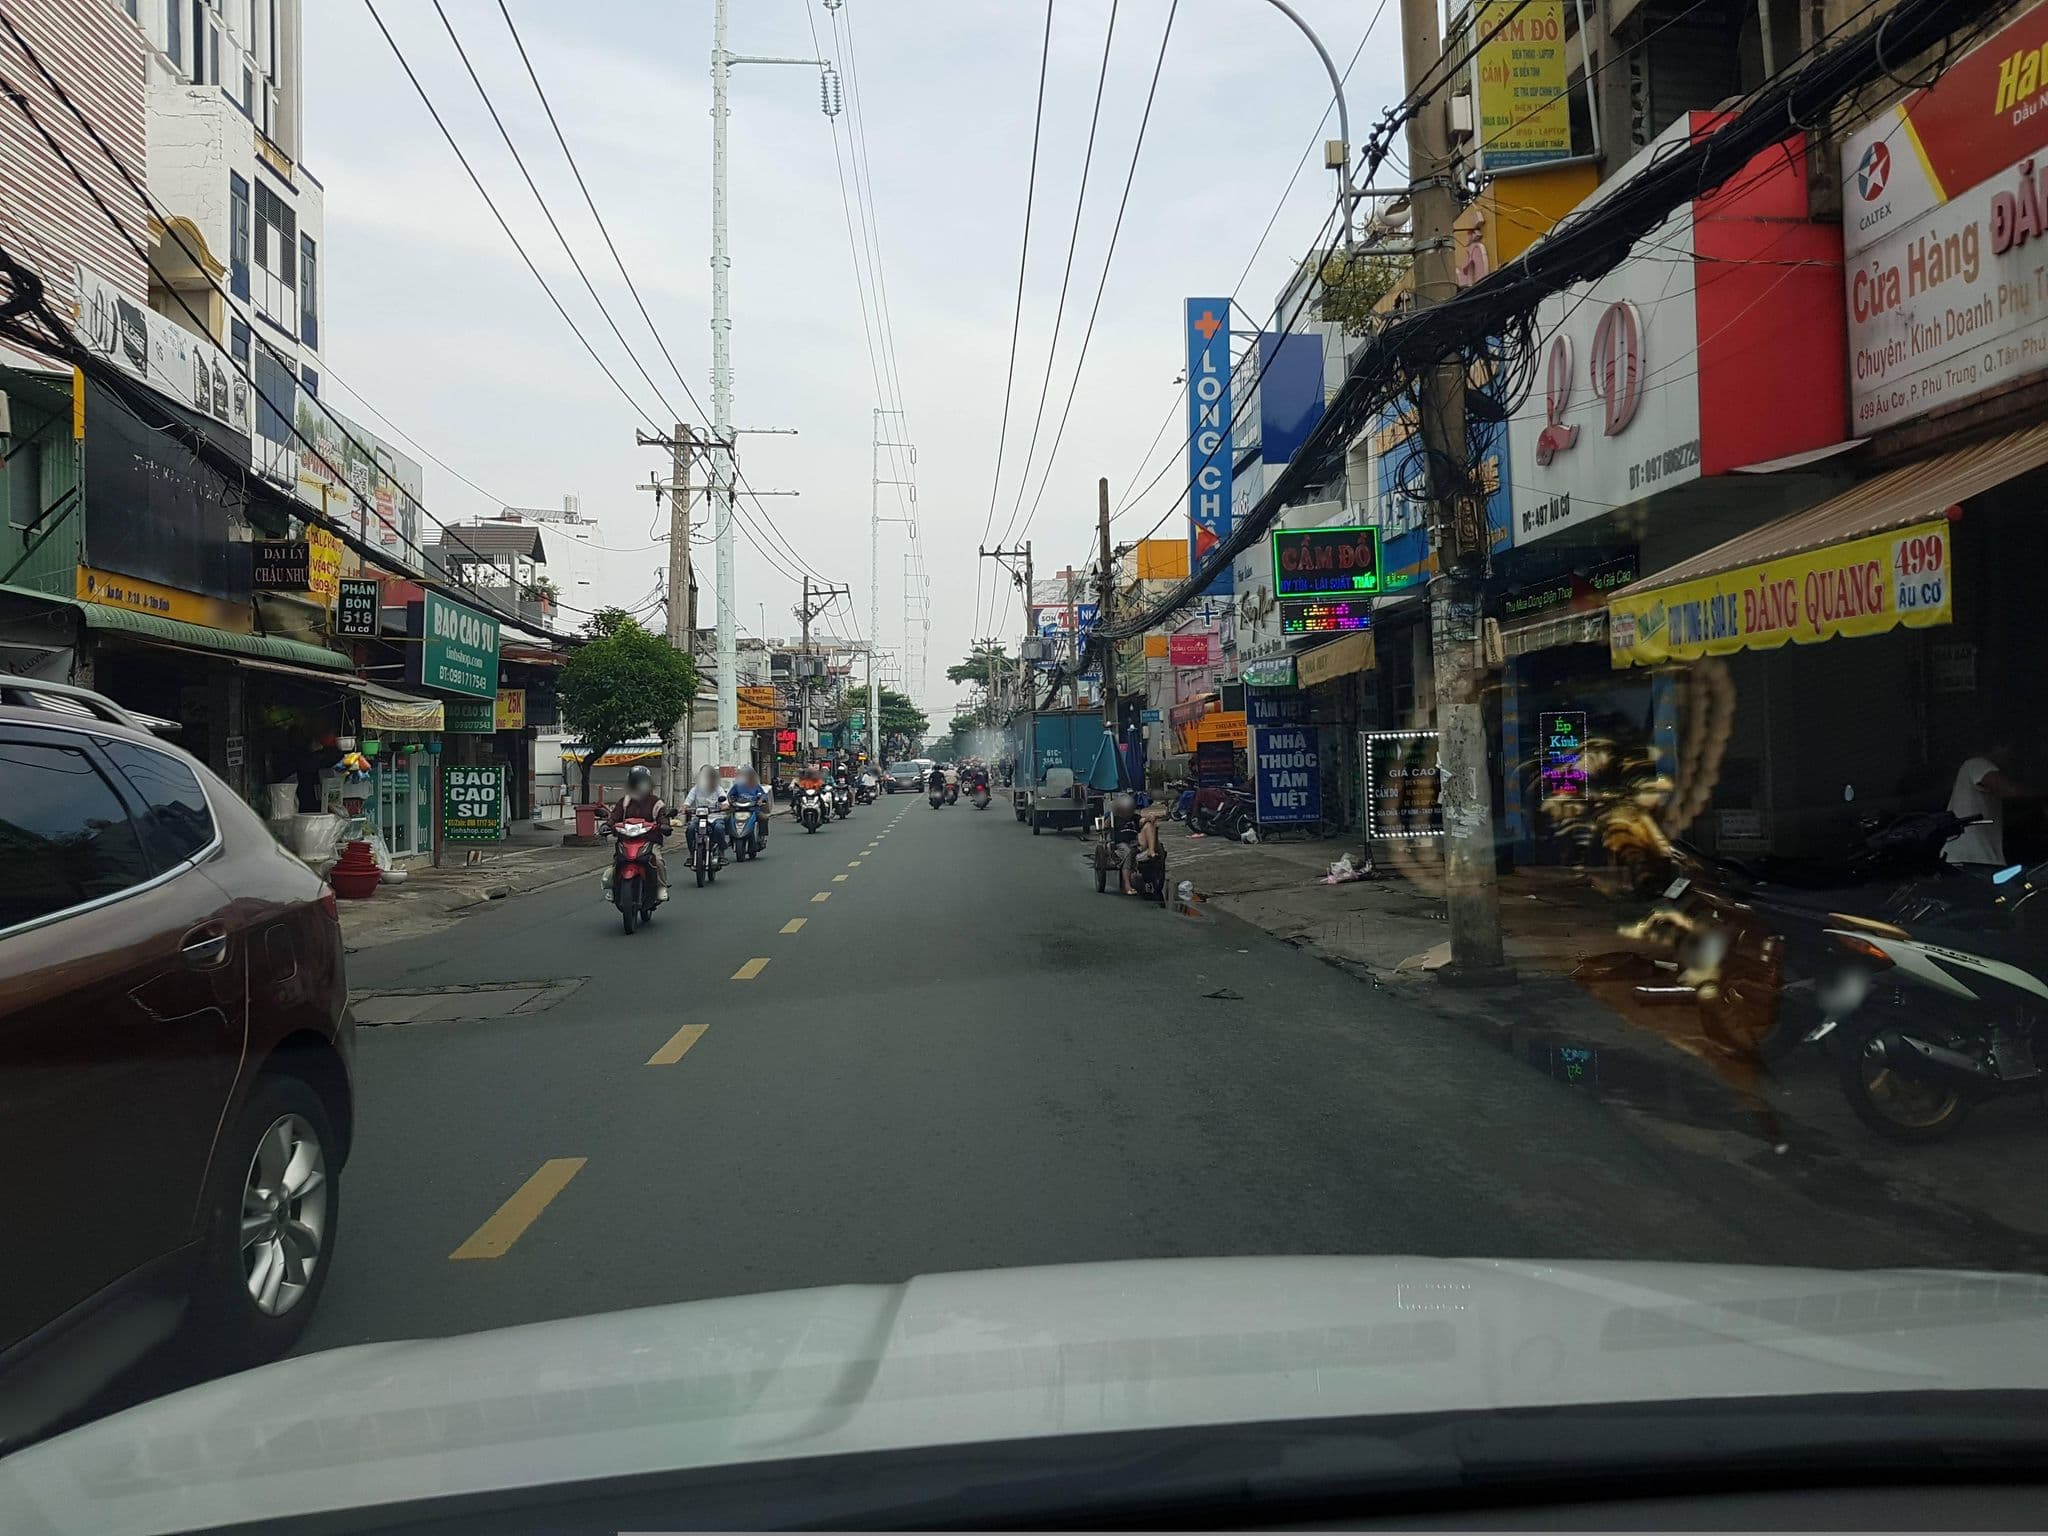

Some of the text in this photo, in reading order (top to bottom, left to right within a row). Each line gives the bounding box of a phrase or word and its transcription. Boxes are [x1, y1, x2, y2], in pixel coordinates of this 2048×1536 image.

[1859, 202, 1892, 231] CALTEX
[1853, 261, 1901, 323] Cửa
[1908, 221, 1980, 297] Hàng
[1911, 316, 1942, 356] Kinh
[1946, 293, 1993, 342] Doanh
[1197, 349, 1222, 456] LONG
[1859, 402, 1874, 420] 499
[290, 543, 305, 559] LÝ
[1895, 535, 1943, 577] 499
[341, 582, 375, 596] PHÂN
[1743, 570, 1797, 634] ĐĂNG
[1805, 560, 1884, 634] QUANG
[1920, 578, 1942, 604] CƠ
[342, 611, 372, 624] 518
[434, 602, 494, 653] BAO CAO SU
[508, 692, 522, 714] 25K
[1554, 716, 1572, 733] Ép
[1269, 731, 1307, 749] NHÀ
[1259, 749, 1317, 769] THUỐC
[450, 772, 495, 785] BAO
[1269, 770, 1308, 788] TÂM
[1412, 768, 1436, 776] CAO
[450, 787, 495, 801] CAO
[1270, 789, 1308, 810] VIỆT
[458, 803, 487, 817] SU
